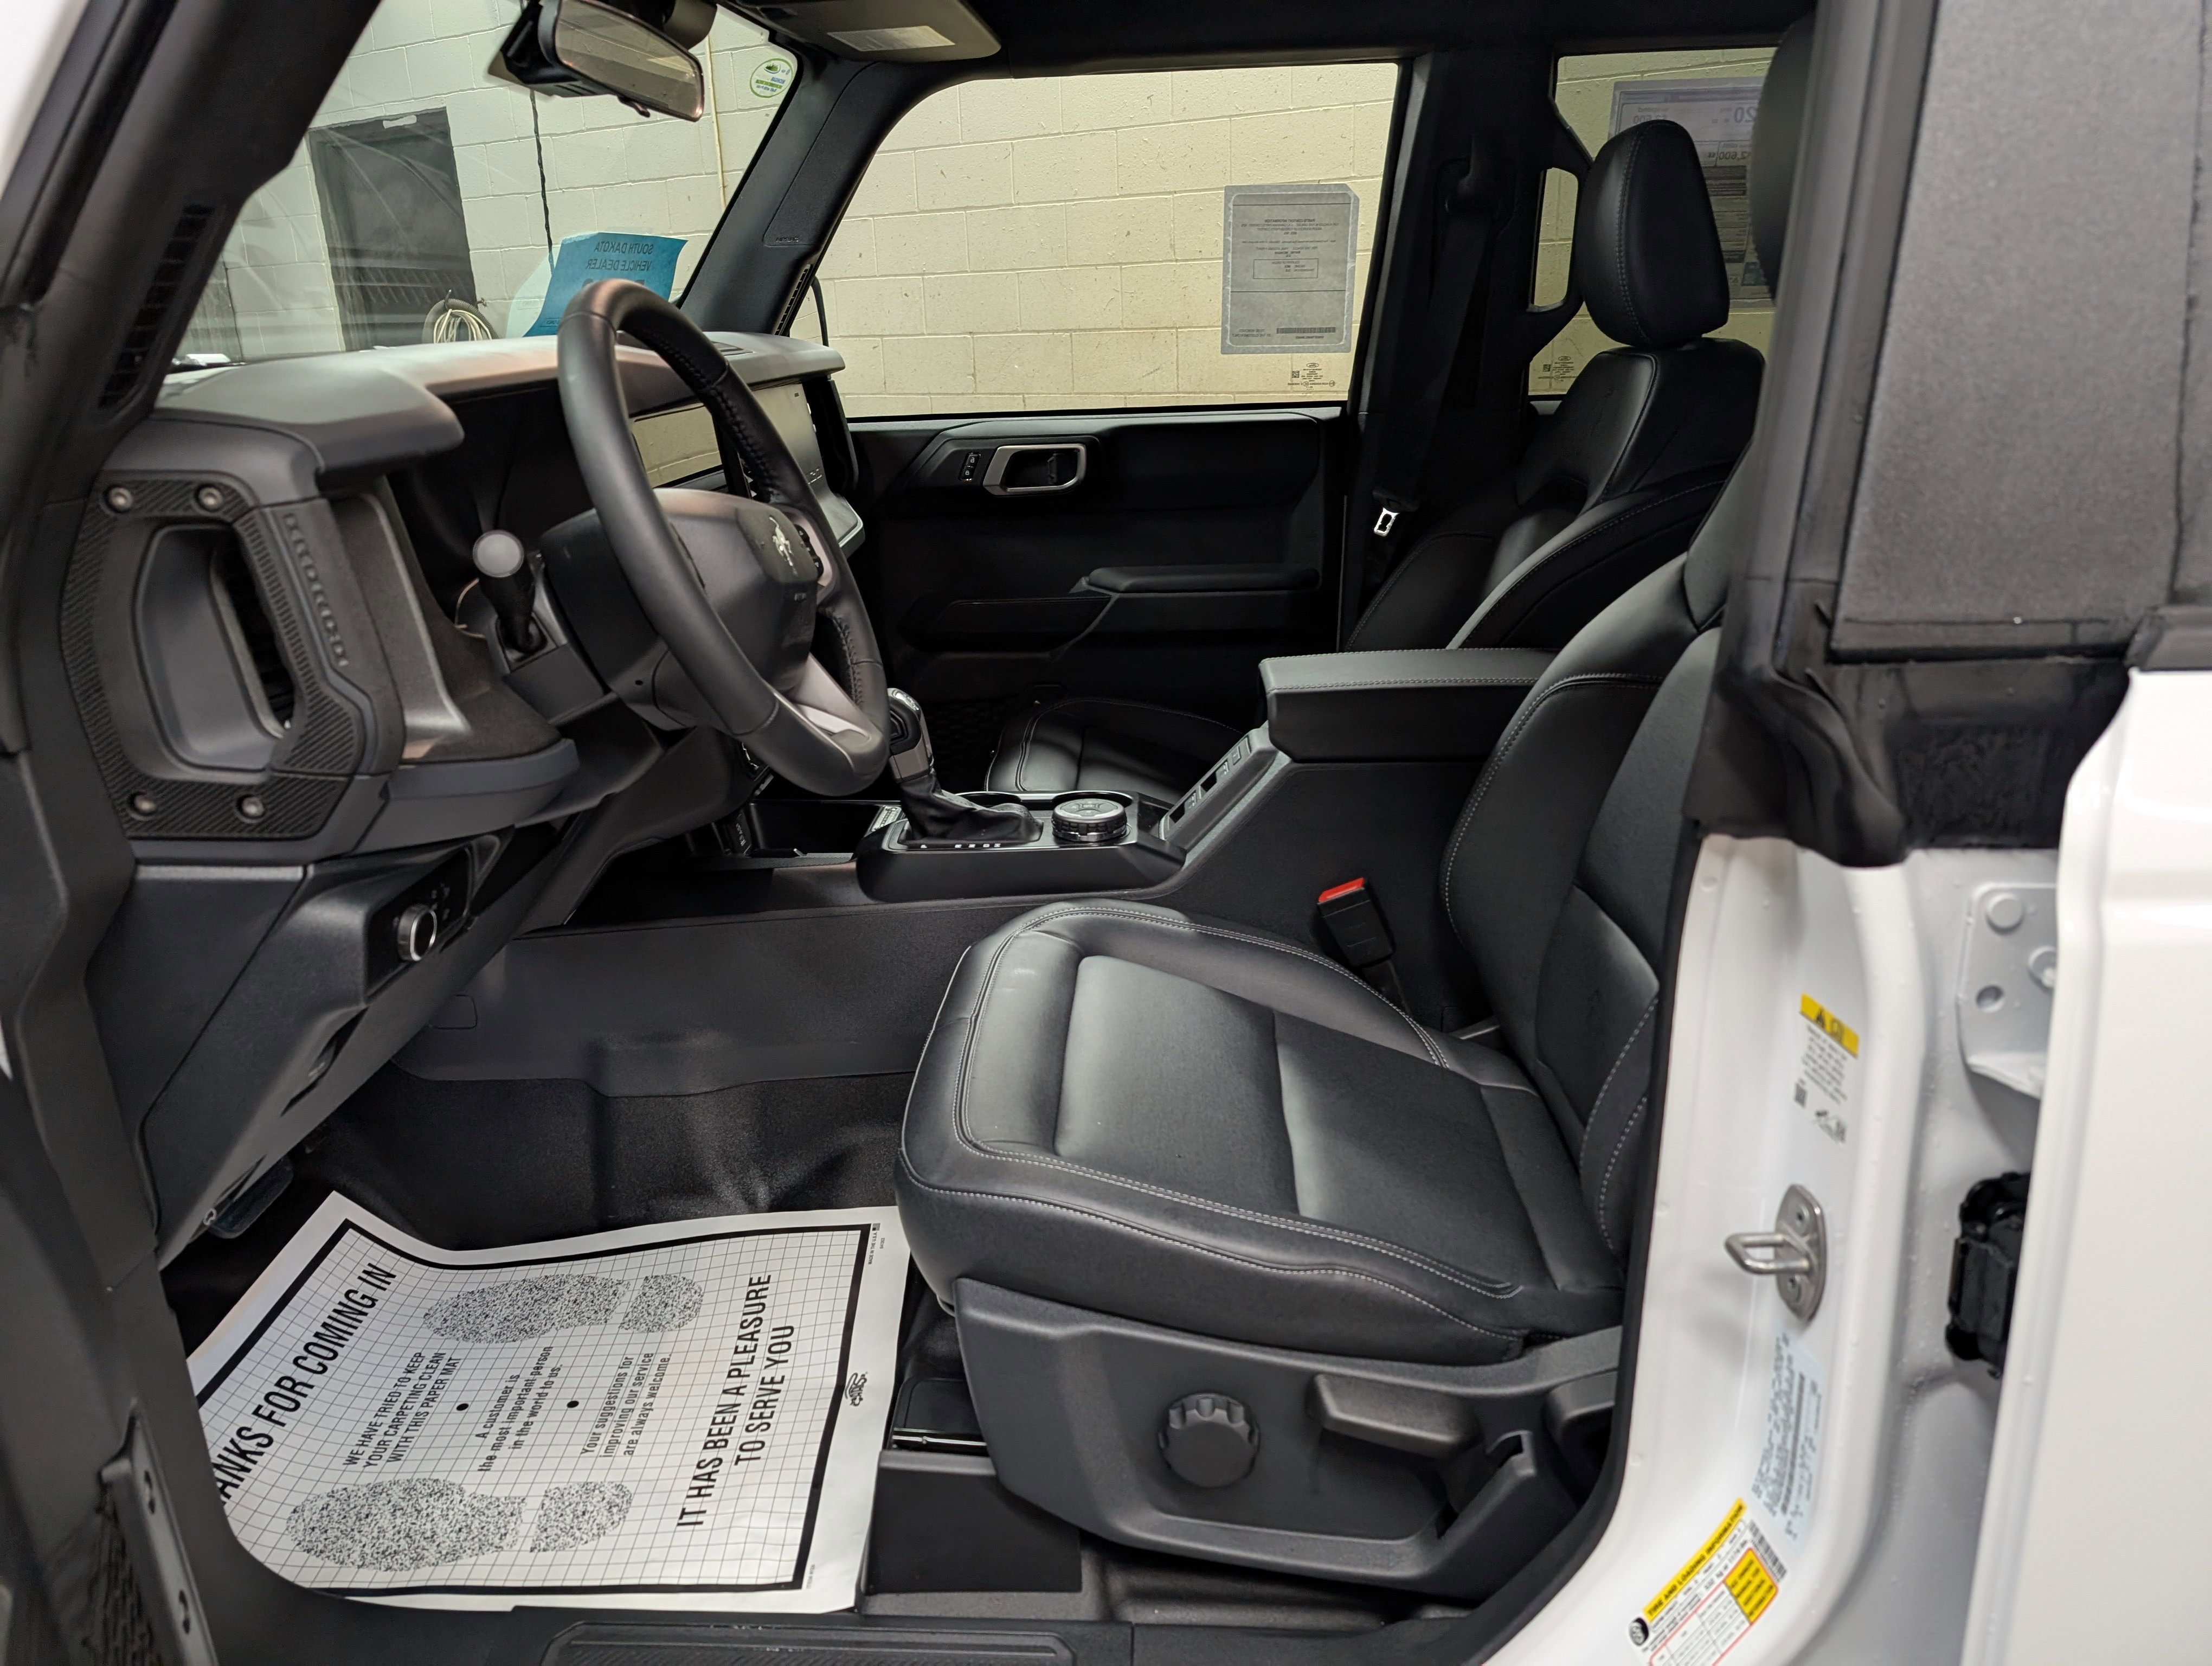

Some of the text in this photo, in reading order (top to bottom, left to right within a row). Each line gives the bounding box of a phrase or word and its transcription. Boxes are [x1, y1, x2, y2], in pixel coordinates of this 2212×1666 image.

[215, 1262, 397, 1505] ANKS FOR COMING IN
[342, 1352, 426, 1466] WE HAVE TRIED TO KEEP
[363, 1352, 447, 1468] YOUR CARPETING CLEAN
[387, 1356, 462, 1463] WITH THIS PAPER MAT
[477, 1346, 554, 1472] the most important person
[483, 1385, 515, 1429] customer
[505, 1374, 520, 1383] is
[507, 1363, 563, 1450] in the world to us.
[580, 1356, 634, 1454] Your suggestions for
[599, 1353, 654, 1458] improving our service
[623, 1354, 672, 1456] are always welcome.
[677, 1274, 772, 1527] IT HAS BEEN A PLEASURE
[734, 1324, 795, 1466] TO SERVE YOU
[1663, 1584, 1678, 1599] AND
[1676, 1554, 1707, 1586] LOADING
